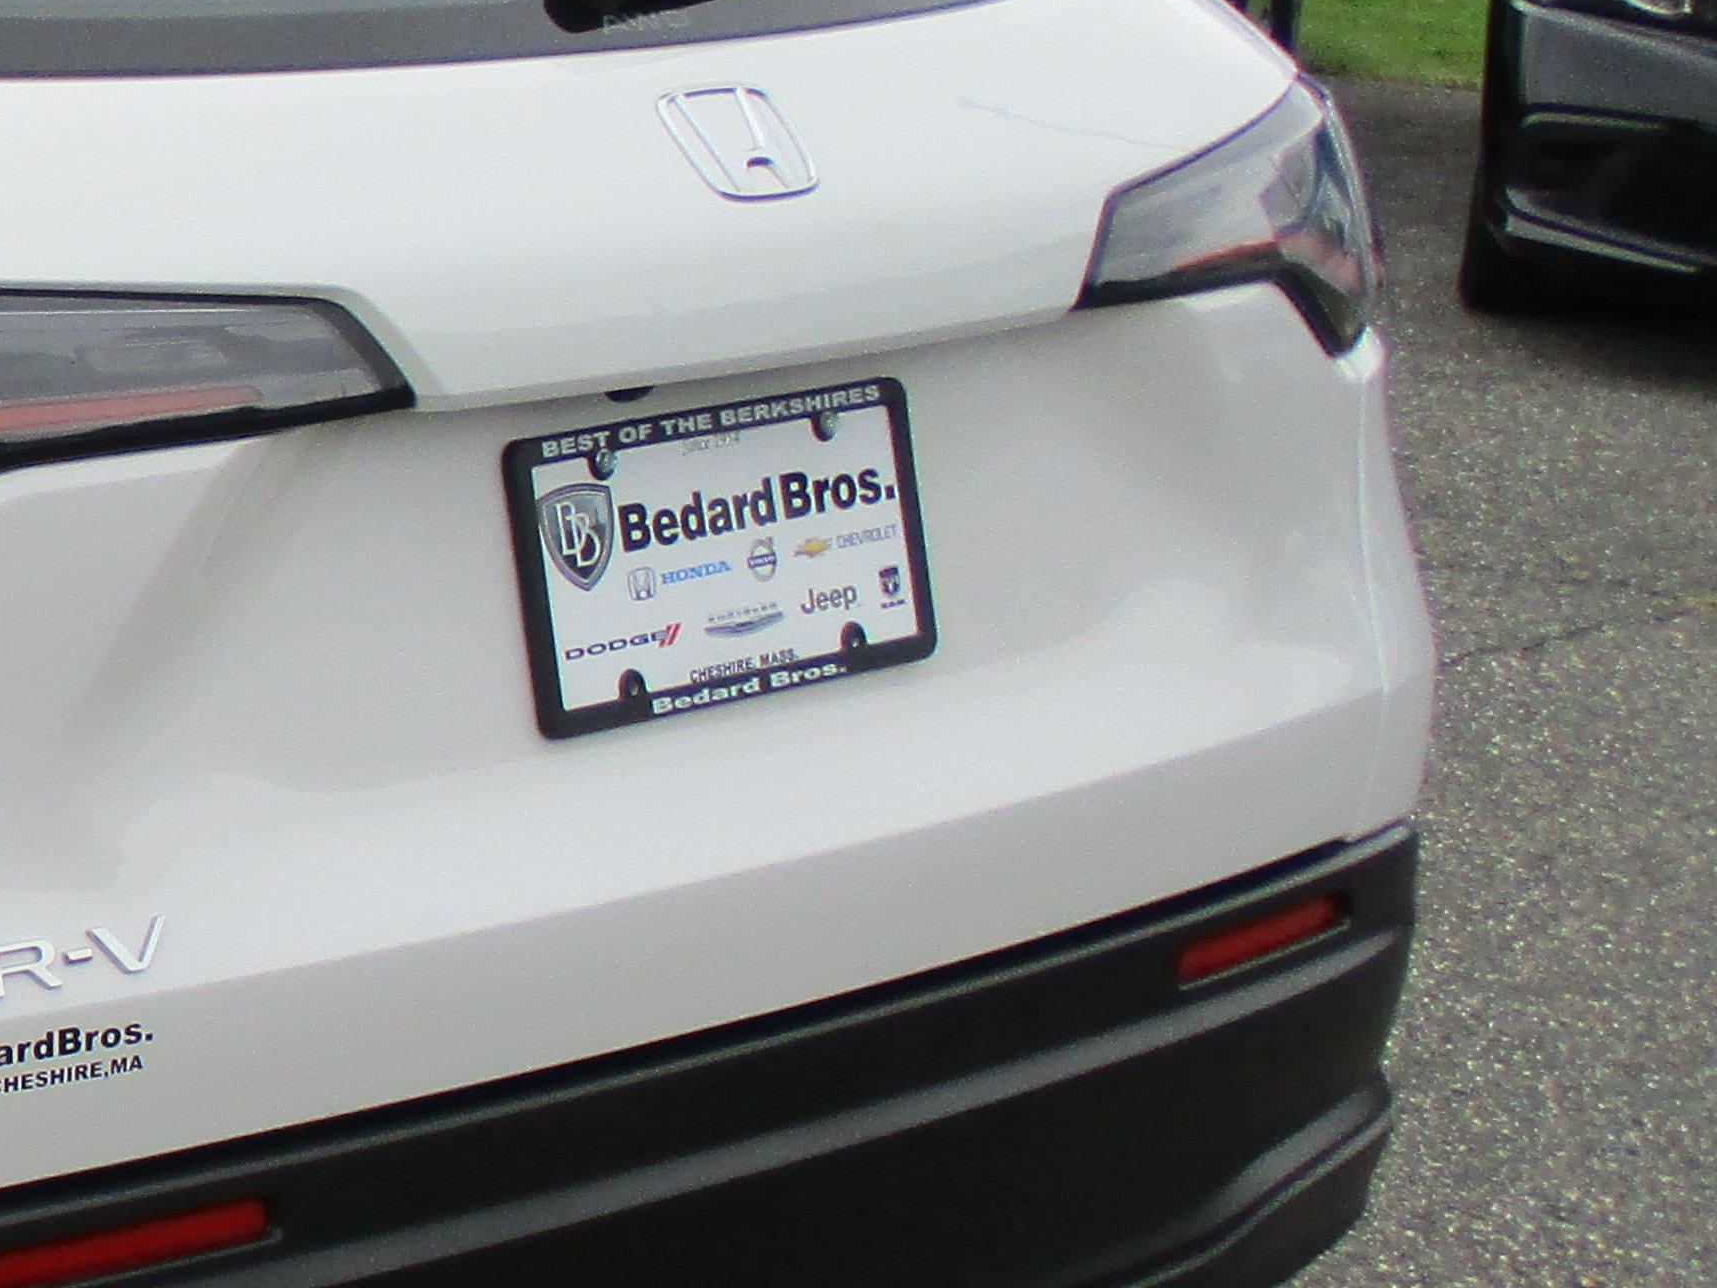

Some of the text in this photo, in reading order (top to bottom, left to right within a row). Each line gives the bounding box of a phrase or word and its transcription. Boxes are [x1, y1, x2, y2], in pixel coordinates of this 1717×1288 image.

[541, 431, 611, 458] BEST
[618, 423, 653, 443] OF
[659, 413, 713, 435] THE
[720, 385, 880, 426] BERKSHIRES
[618, 468, 897, 553] Bedard Bros.
[661, 560, 733, 585] HONDA
[800, 585, 857, 614] Jeep
[565, 628, 667, 661] DODGE
[652, 663, 848, 715] Bedard Bros.
